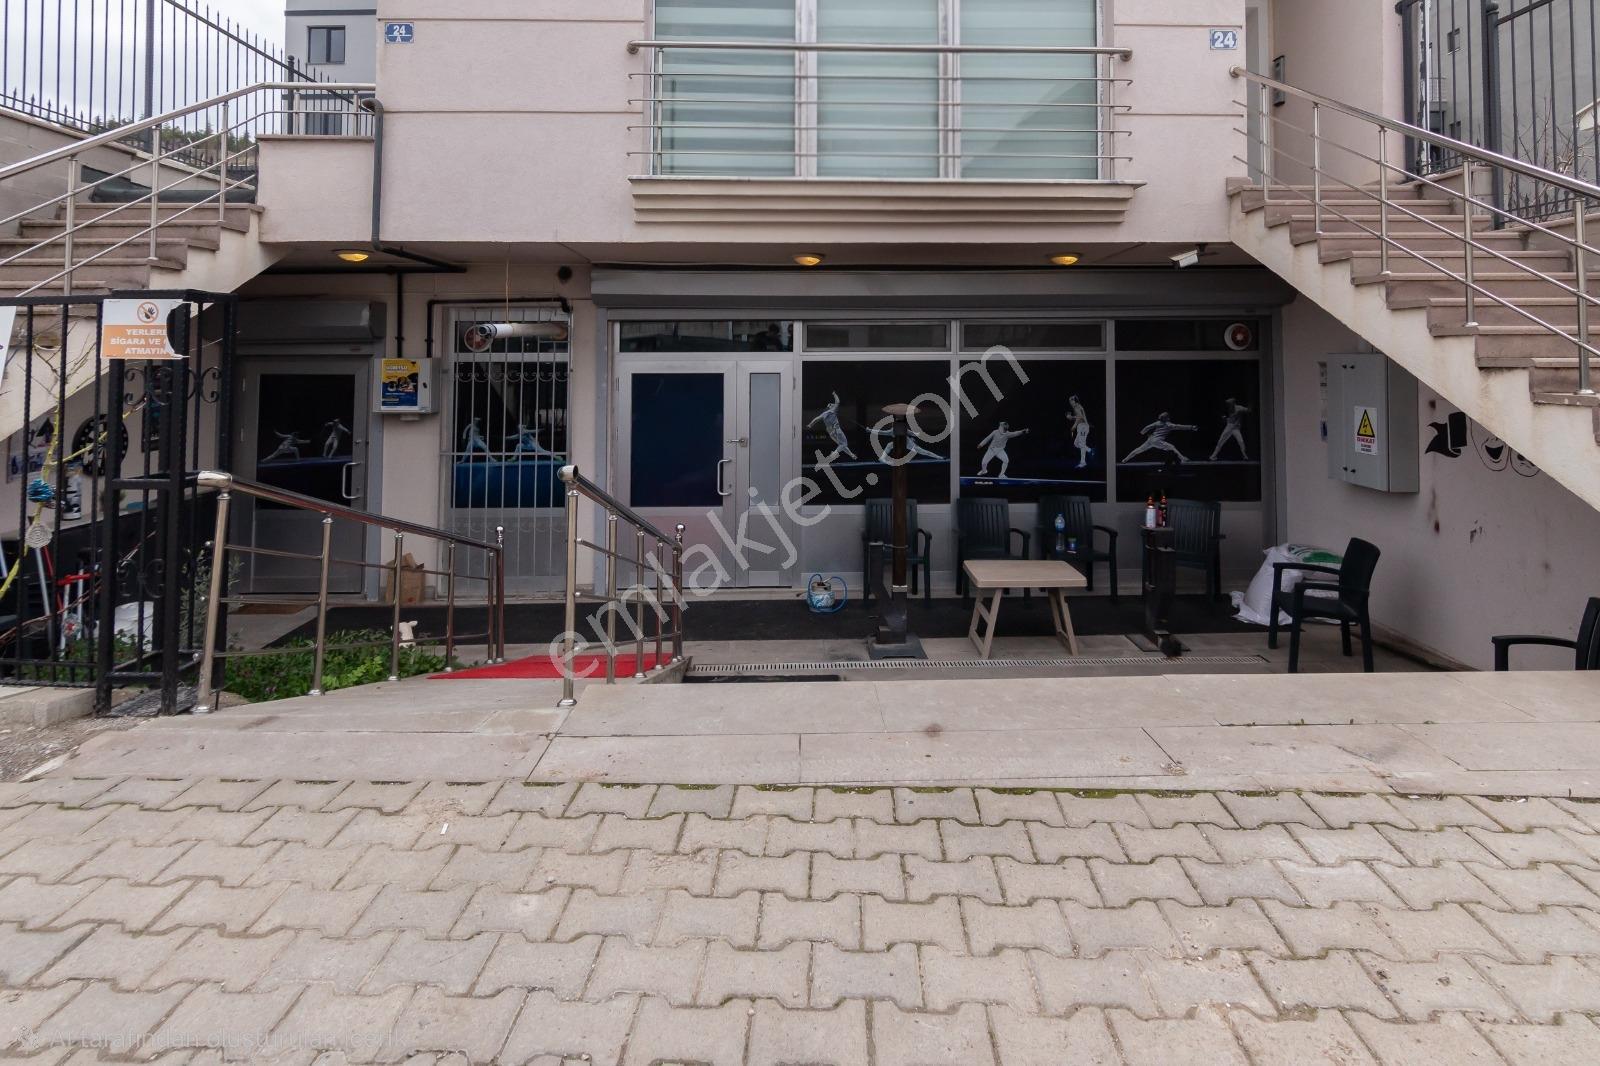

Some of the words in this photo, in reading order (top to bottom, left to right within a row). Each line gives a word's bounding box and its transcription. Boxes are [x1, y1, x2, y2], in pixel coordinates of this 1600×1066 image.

[393, 25, 406, 36] 24
[1213, 31, 1235, 48] 24
[110, 336, 145, 345] SİGARA
[148, 337, 161, 345] VE
